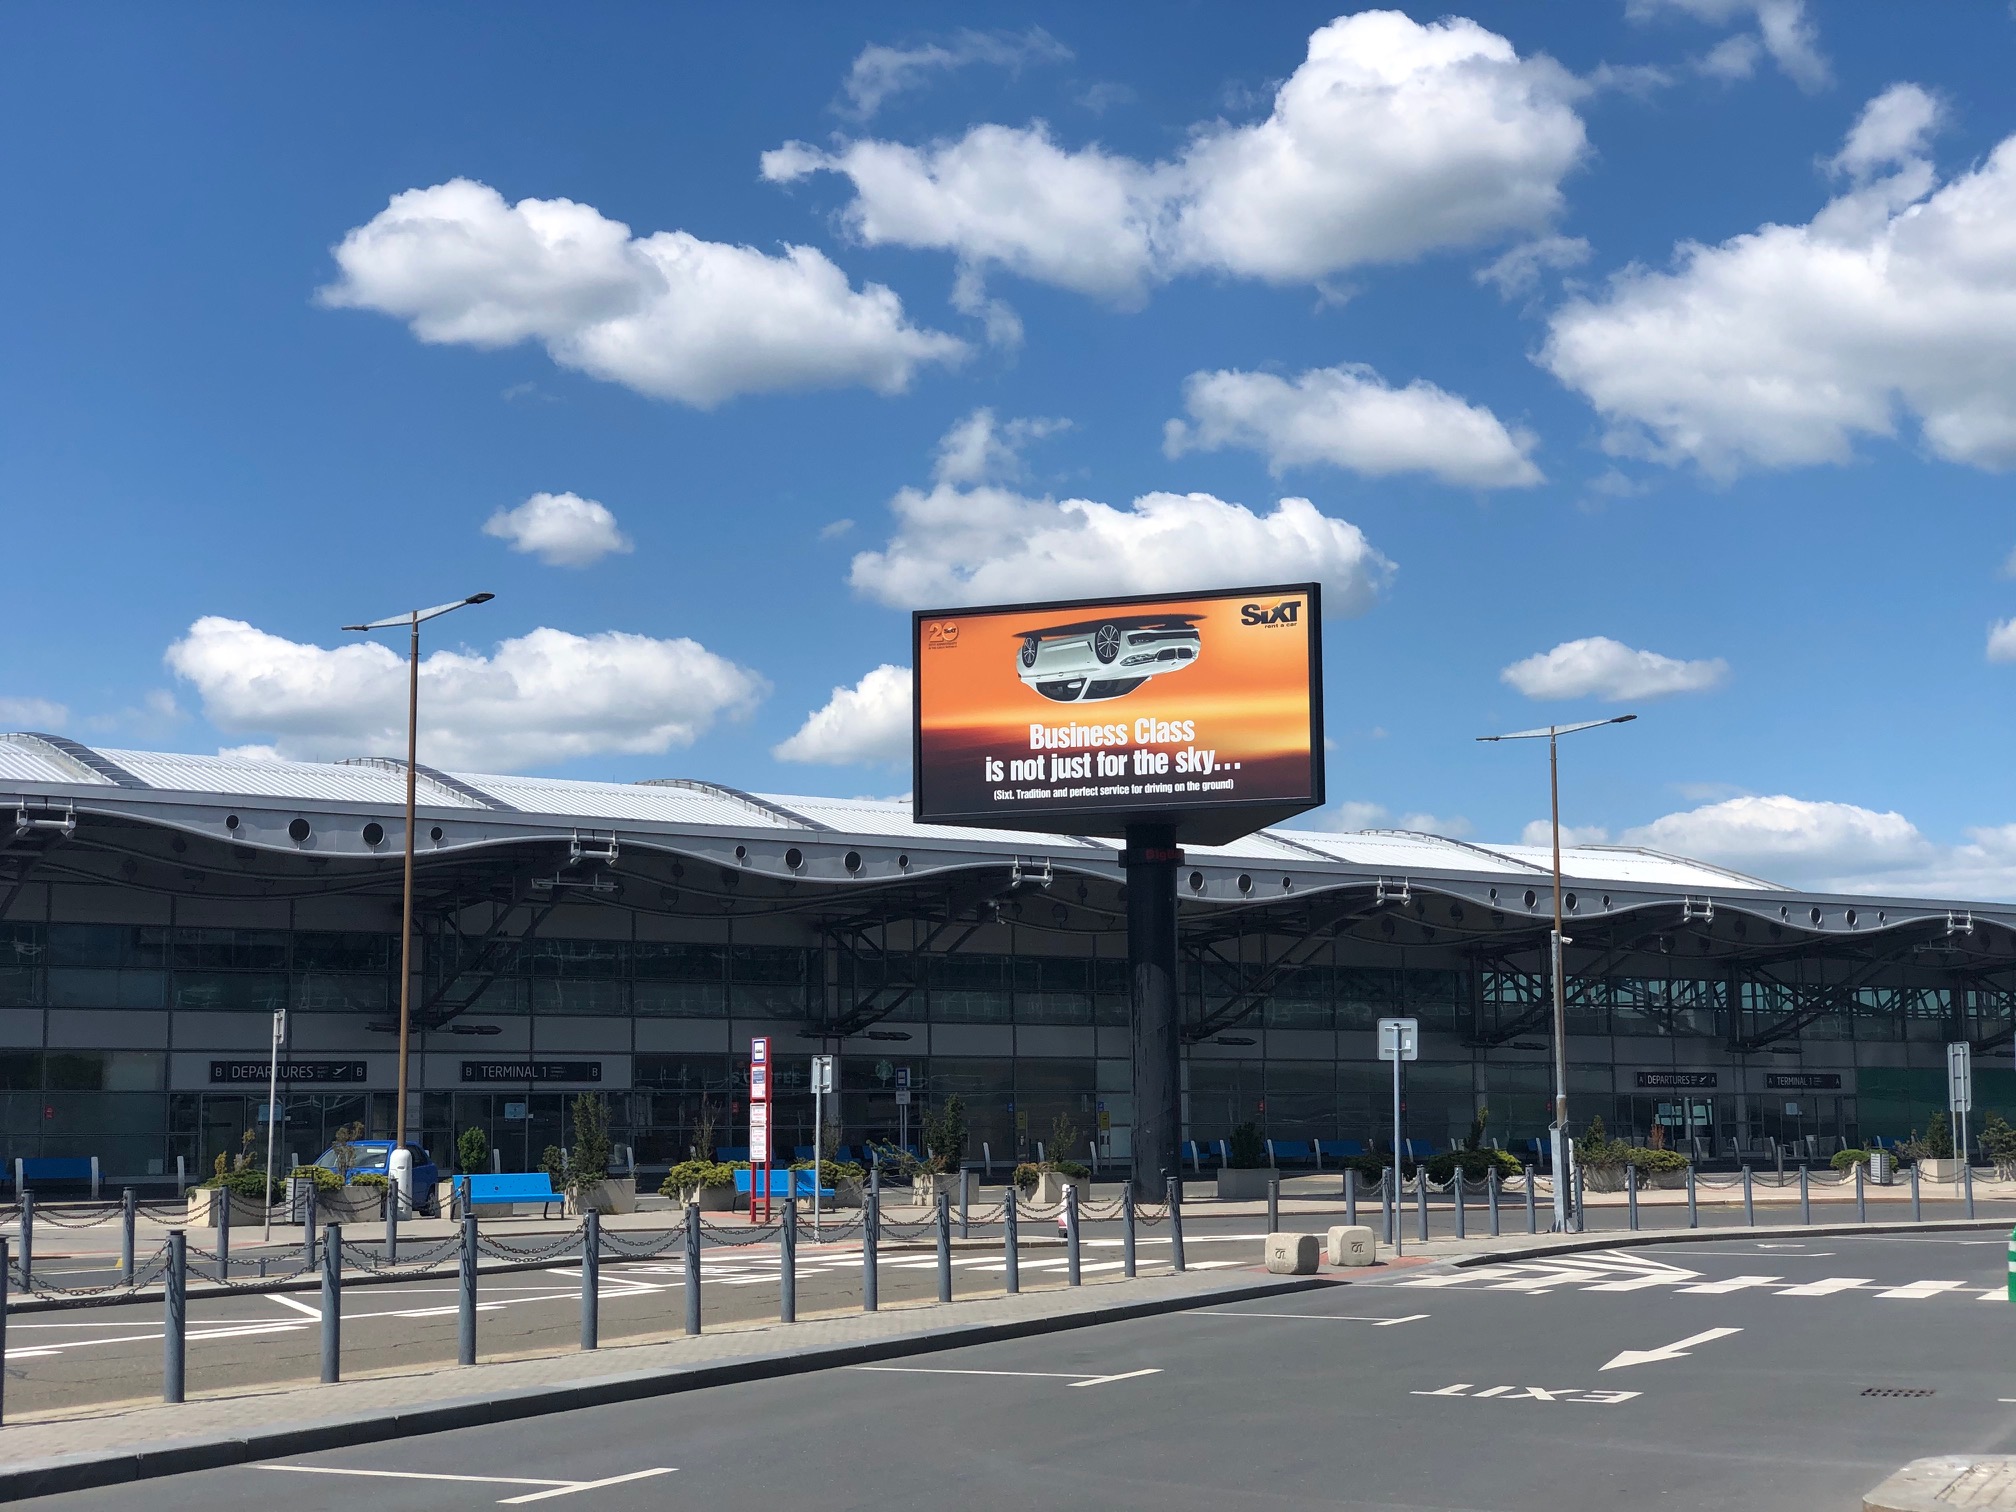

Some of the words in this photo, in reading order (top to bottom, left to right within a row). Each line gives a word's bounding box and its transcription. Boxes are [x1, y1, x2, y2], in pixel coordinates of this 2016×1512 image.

[1029, 721, 1128, 750] Business
[1134, 717, 1196, 745] Class
[985, 756, 1005, 782] is
[1010, 754, 1046, 782] not
[1050, 753, 1092, 783] just
[1096, 750, 1128, 777] for
[1132, 748, 1169, 776] the
[1175, 746, 1241, 775] sky...
[993, 789, 1015, 801] (Sixt.
[1016, 788, 1051, 800] Tradition
[1052, 787, 1068, 798] and
[1069, 785, 1099, 798] perfect
[1100, 784, 1130, 796] service
[1131, 783, 1143, 795] for
[1144, 782, 1173, 794] driving
[1174, 782, 1186, 792] on
[1187, 780, 1201, 792] the
[1202, 779, 1234, 792] ground)
[215, 1067, 223, 1077] B
[231, 1065, 314, 1079] DEPARTURES
[356, 1067, 363, 1077] B
[481, 1065, 538, 1078] TERMINAL
[541, 1066, 547, 1078] 1
[592, 1067, 598, 1077] B
[1647, 1074, 1690, 1085] DEPARTURES
[1776, 1076, 1807, 1086] TERMINAL
[1410, 1383, 1644, 1404] EXIT
